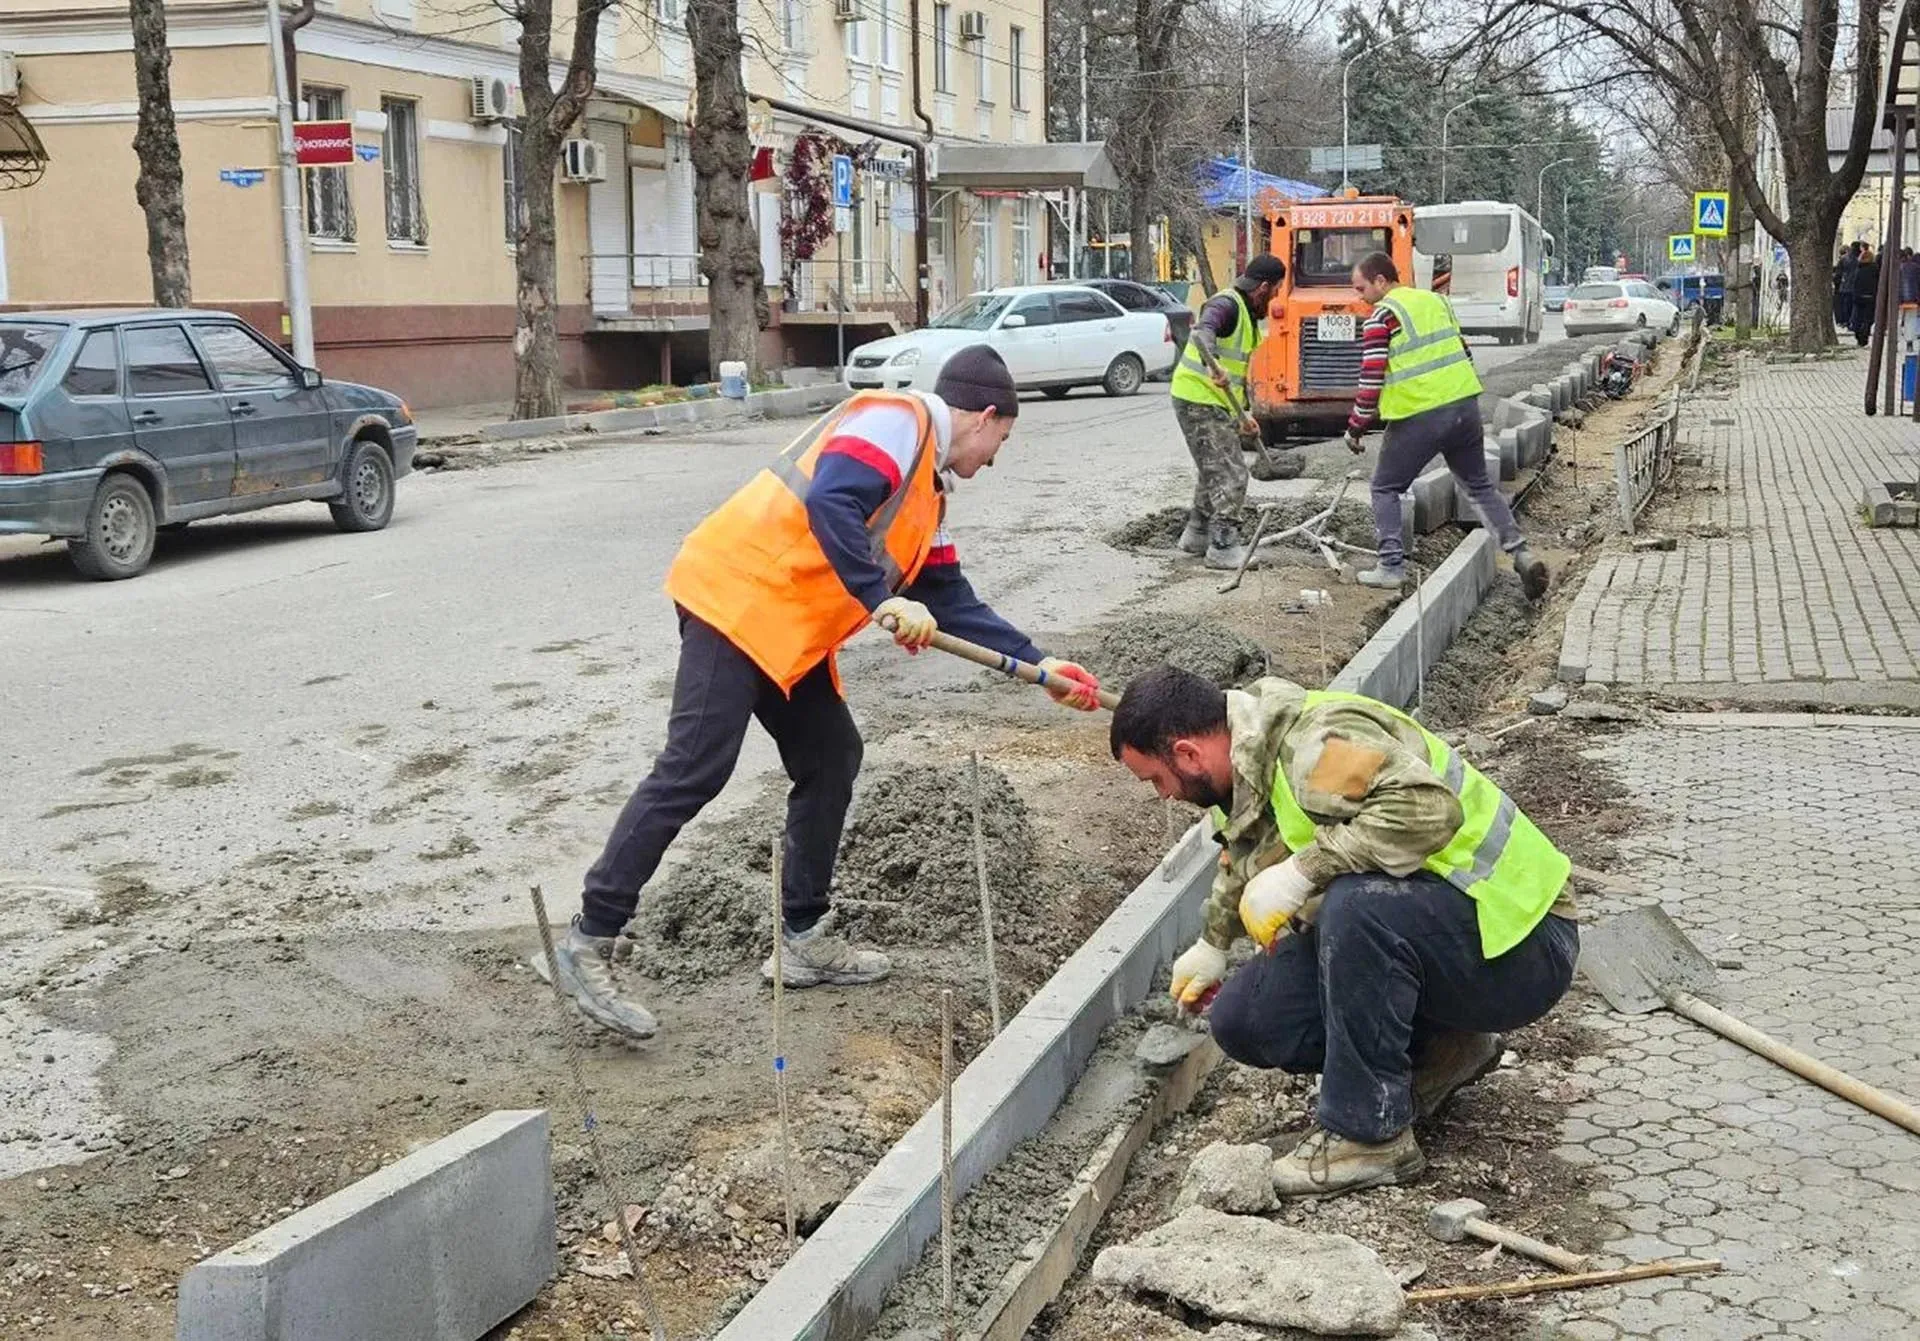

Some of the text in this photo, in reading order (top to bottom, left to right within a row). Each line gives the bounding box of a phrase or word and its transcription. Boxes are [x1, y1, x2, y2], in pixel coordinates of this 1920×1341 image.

[303, 138, 352, 149] НОТАРИУС
[1291, 210, 1393, 226] 8 928 720 21 91
